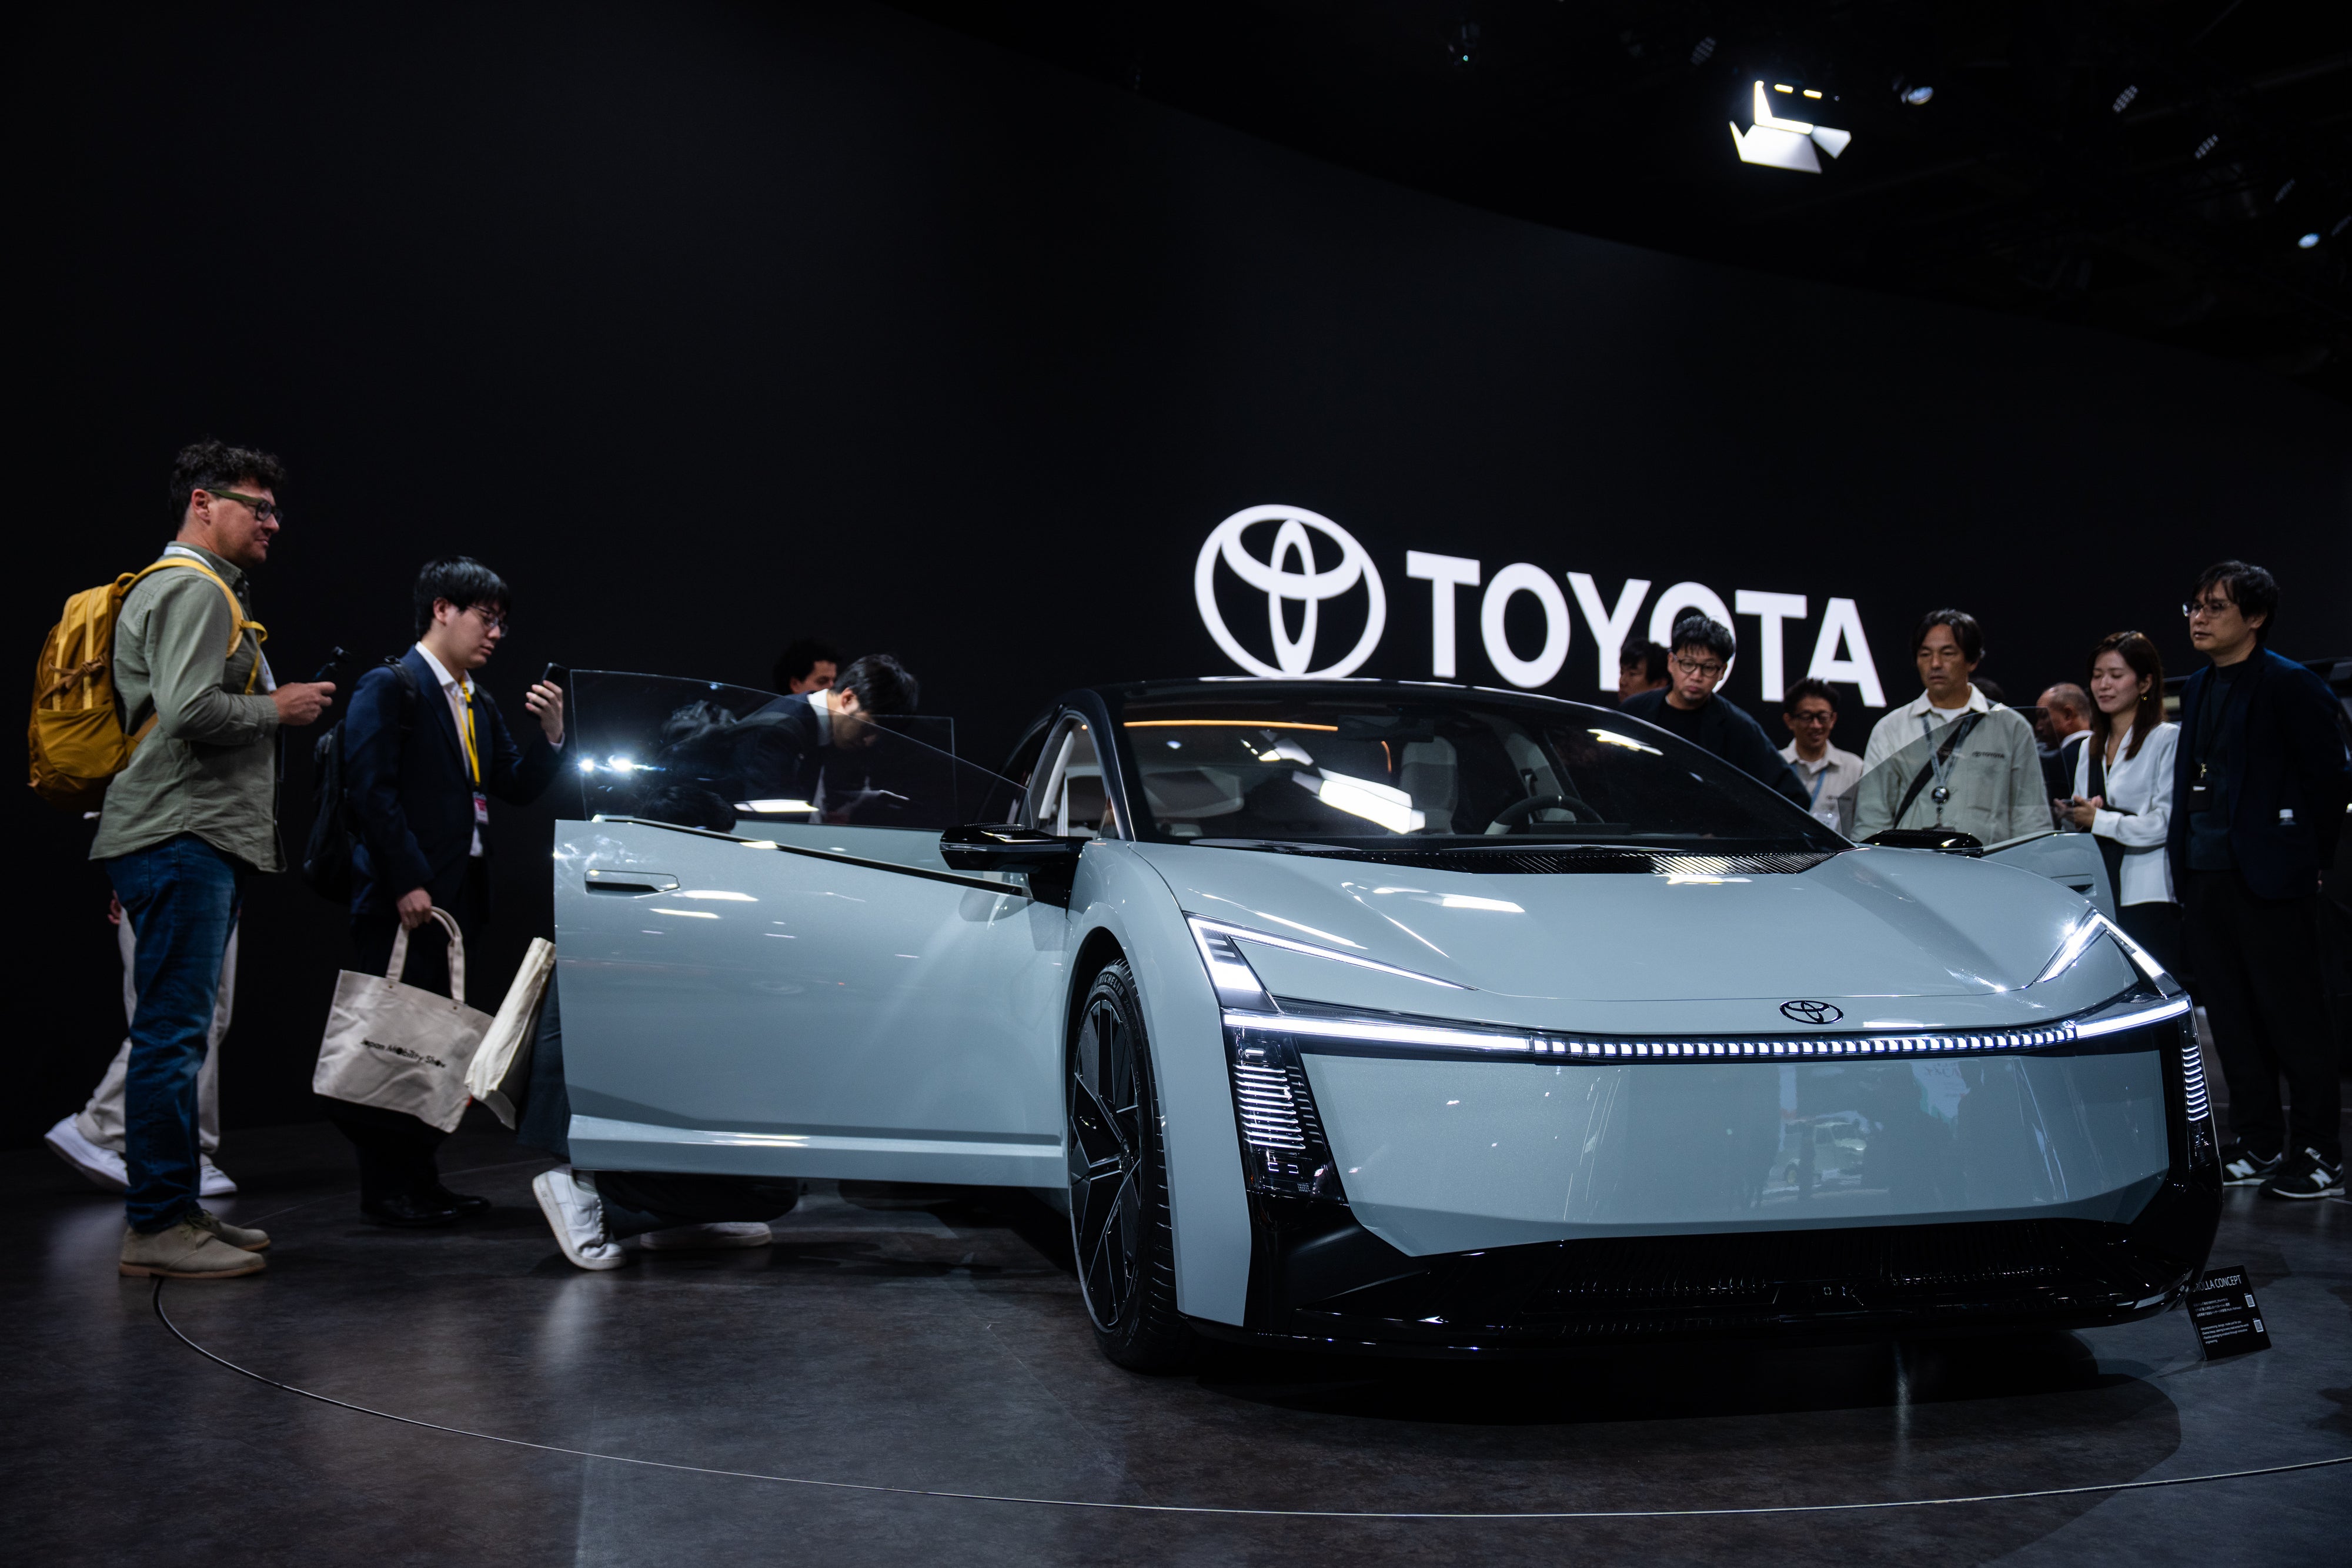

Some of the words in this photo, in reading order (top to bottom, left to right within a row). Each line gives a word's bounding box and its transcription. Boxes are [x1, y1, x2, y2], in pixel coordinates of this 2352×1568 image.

[1406, 550, 1887, 708] TOYOTA
[1097, 973, 1124, 997] MICHELIN
[2214, 1275, 2242, 1288] CONCEPT
